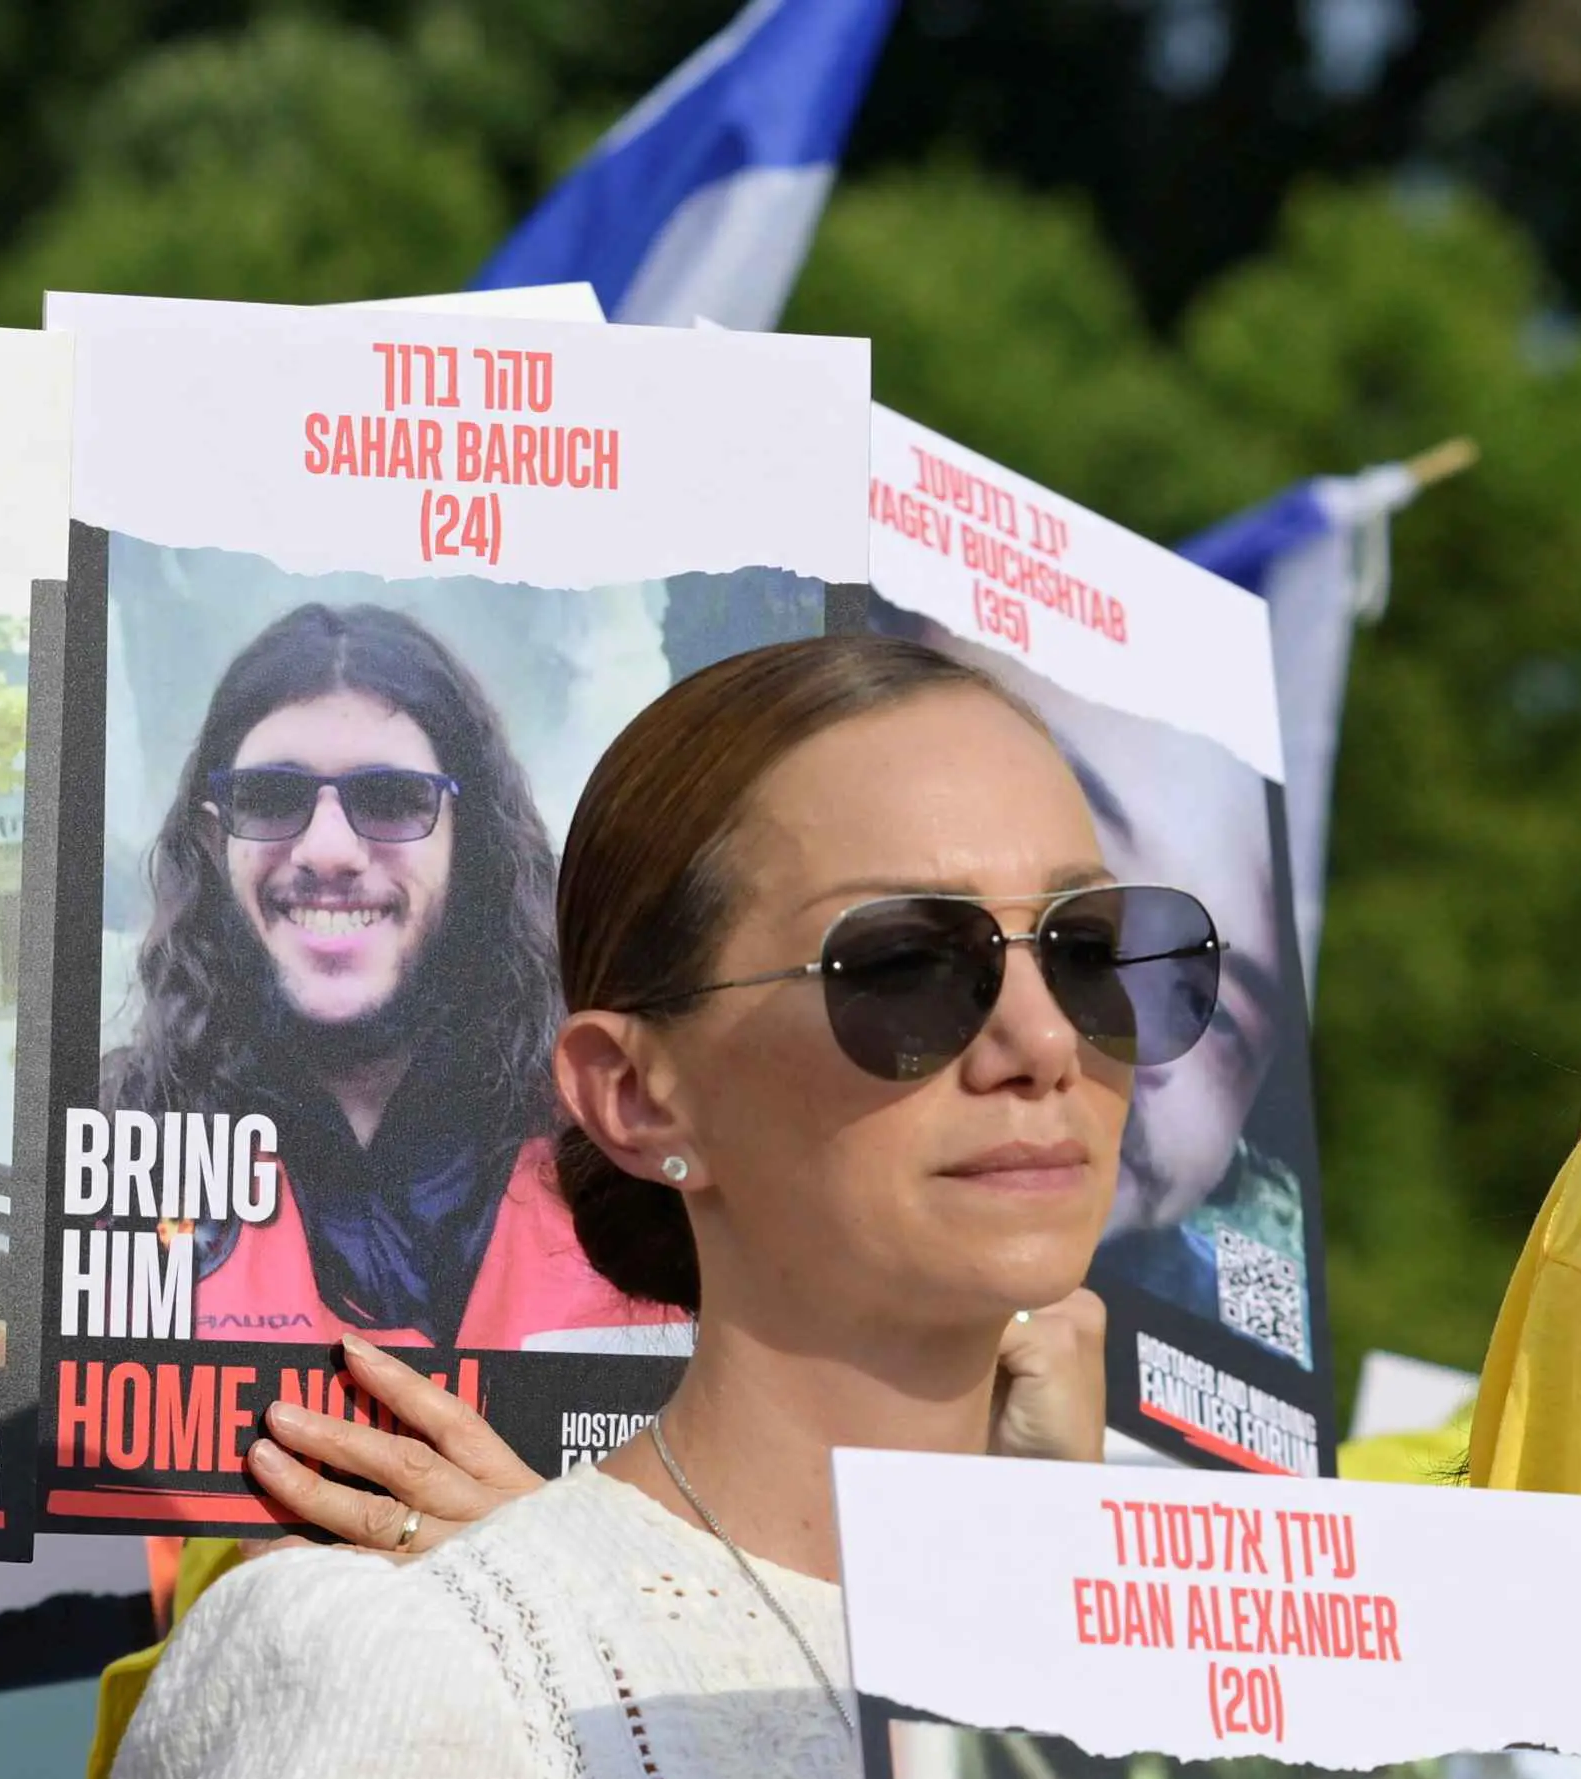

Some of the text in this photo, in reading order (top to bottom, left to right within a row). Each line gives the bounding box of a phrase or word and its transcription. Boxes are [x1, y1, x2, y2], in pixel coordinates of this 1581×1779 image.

[373, 343, 553, 413] סהר ברוך
[304, 412, 619, 490] SAHAR BARUCH
[420, 489, 502, 565] (24)
[1026, 503, 1068, 559] יגב
[961, 521, 1127, 644] BUCHSHTAB
[974, 578, 1030, 653] (35)
[64, 1107, 277, 1222] BRING
[61, 1229, 195, 1340] HIM
[57, 1360, 258, 1473] HOME
[562, 1412, 654, 1447] HOSTAG
[1139, 1364, 1318, 1477] FAMILIES FORUM
[1101, 1499, 1357, 1584] עידן אלכסנדר
[1074, 1577, 1402, 1662] EDAN ALEXANDER
[1208, 1662, 1285, 1743] (20)
